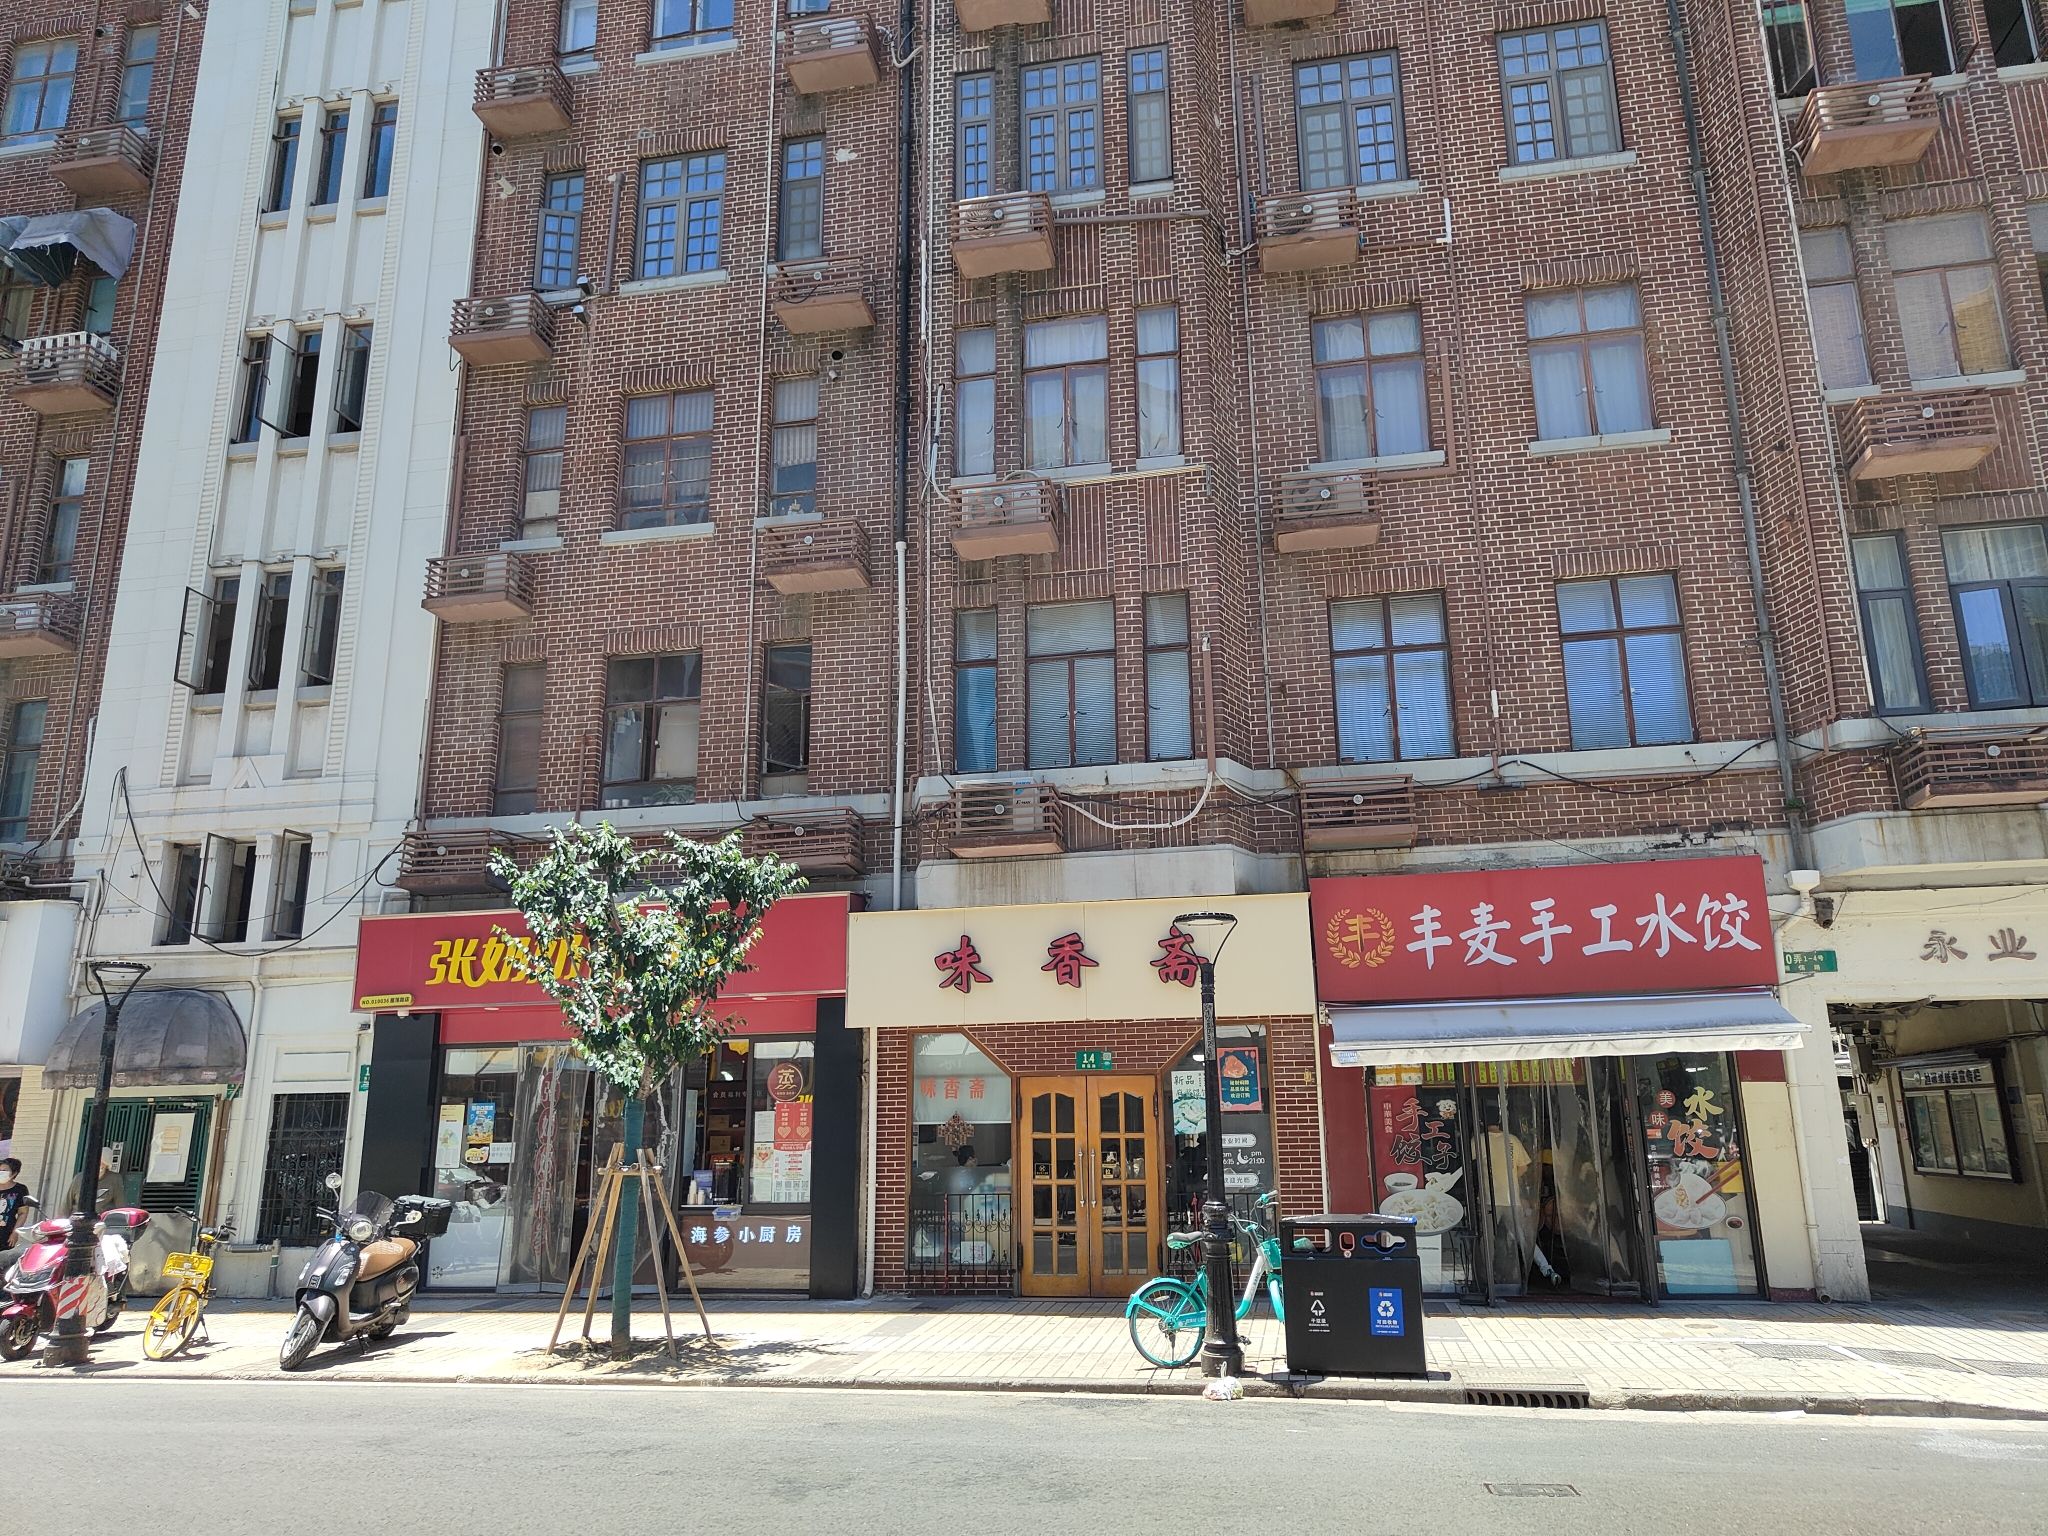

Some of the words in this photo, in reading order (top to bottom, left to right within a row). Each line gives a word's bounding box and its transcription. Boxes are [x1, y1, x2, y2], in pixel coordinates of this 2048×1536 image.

[1341, 914, 1381, 952] 丰
[1406, 893, 1762, 970] 丰麦手工水饺
[1920, 927, 2038, 964] 永业
[935, 925, 1210, 994] 味香斋
[1083, 1053, 1095, 1063] 14
[921, 1075, 986, 1100] 味香斋
[1174, 1075, 1195, 1086] 新品
[1651, 1092, 1673, 1126] 美味
[1667, 1086, 1725, 1159] 水饺
[690, 1225, 803, 1244] 海参小厨房
